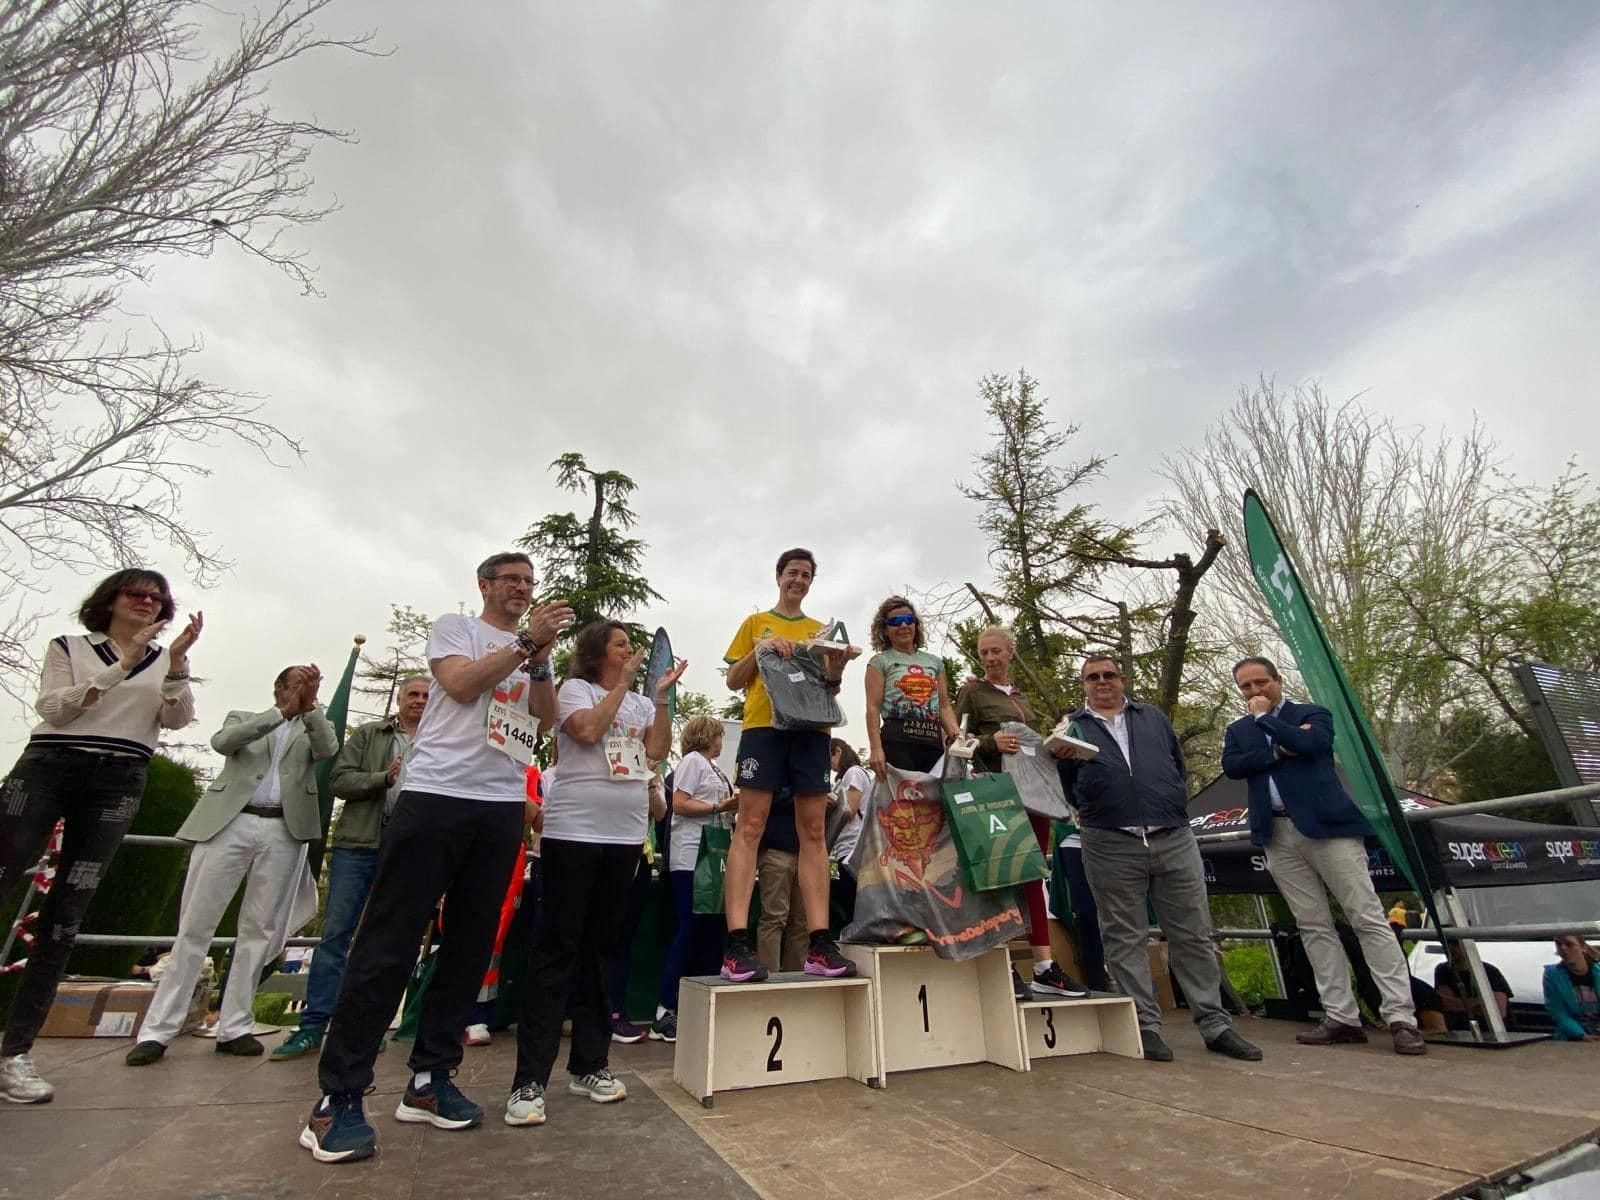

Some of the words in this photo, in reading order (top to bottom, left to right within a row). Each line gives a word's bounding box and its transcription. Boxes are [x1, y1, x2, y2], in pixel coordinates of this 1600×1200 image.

[503, 723, 534, 749] 1448
[634, 754, 640, 767] 1
[917, 984, 930, 1033] 1
[1040, 1007, 1056, 1049] 3
[766, 1016, 783, 1072] 2
